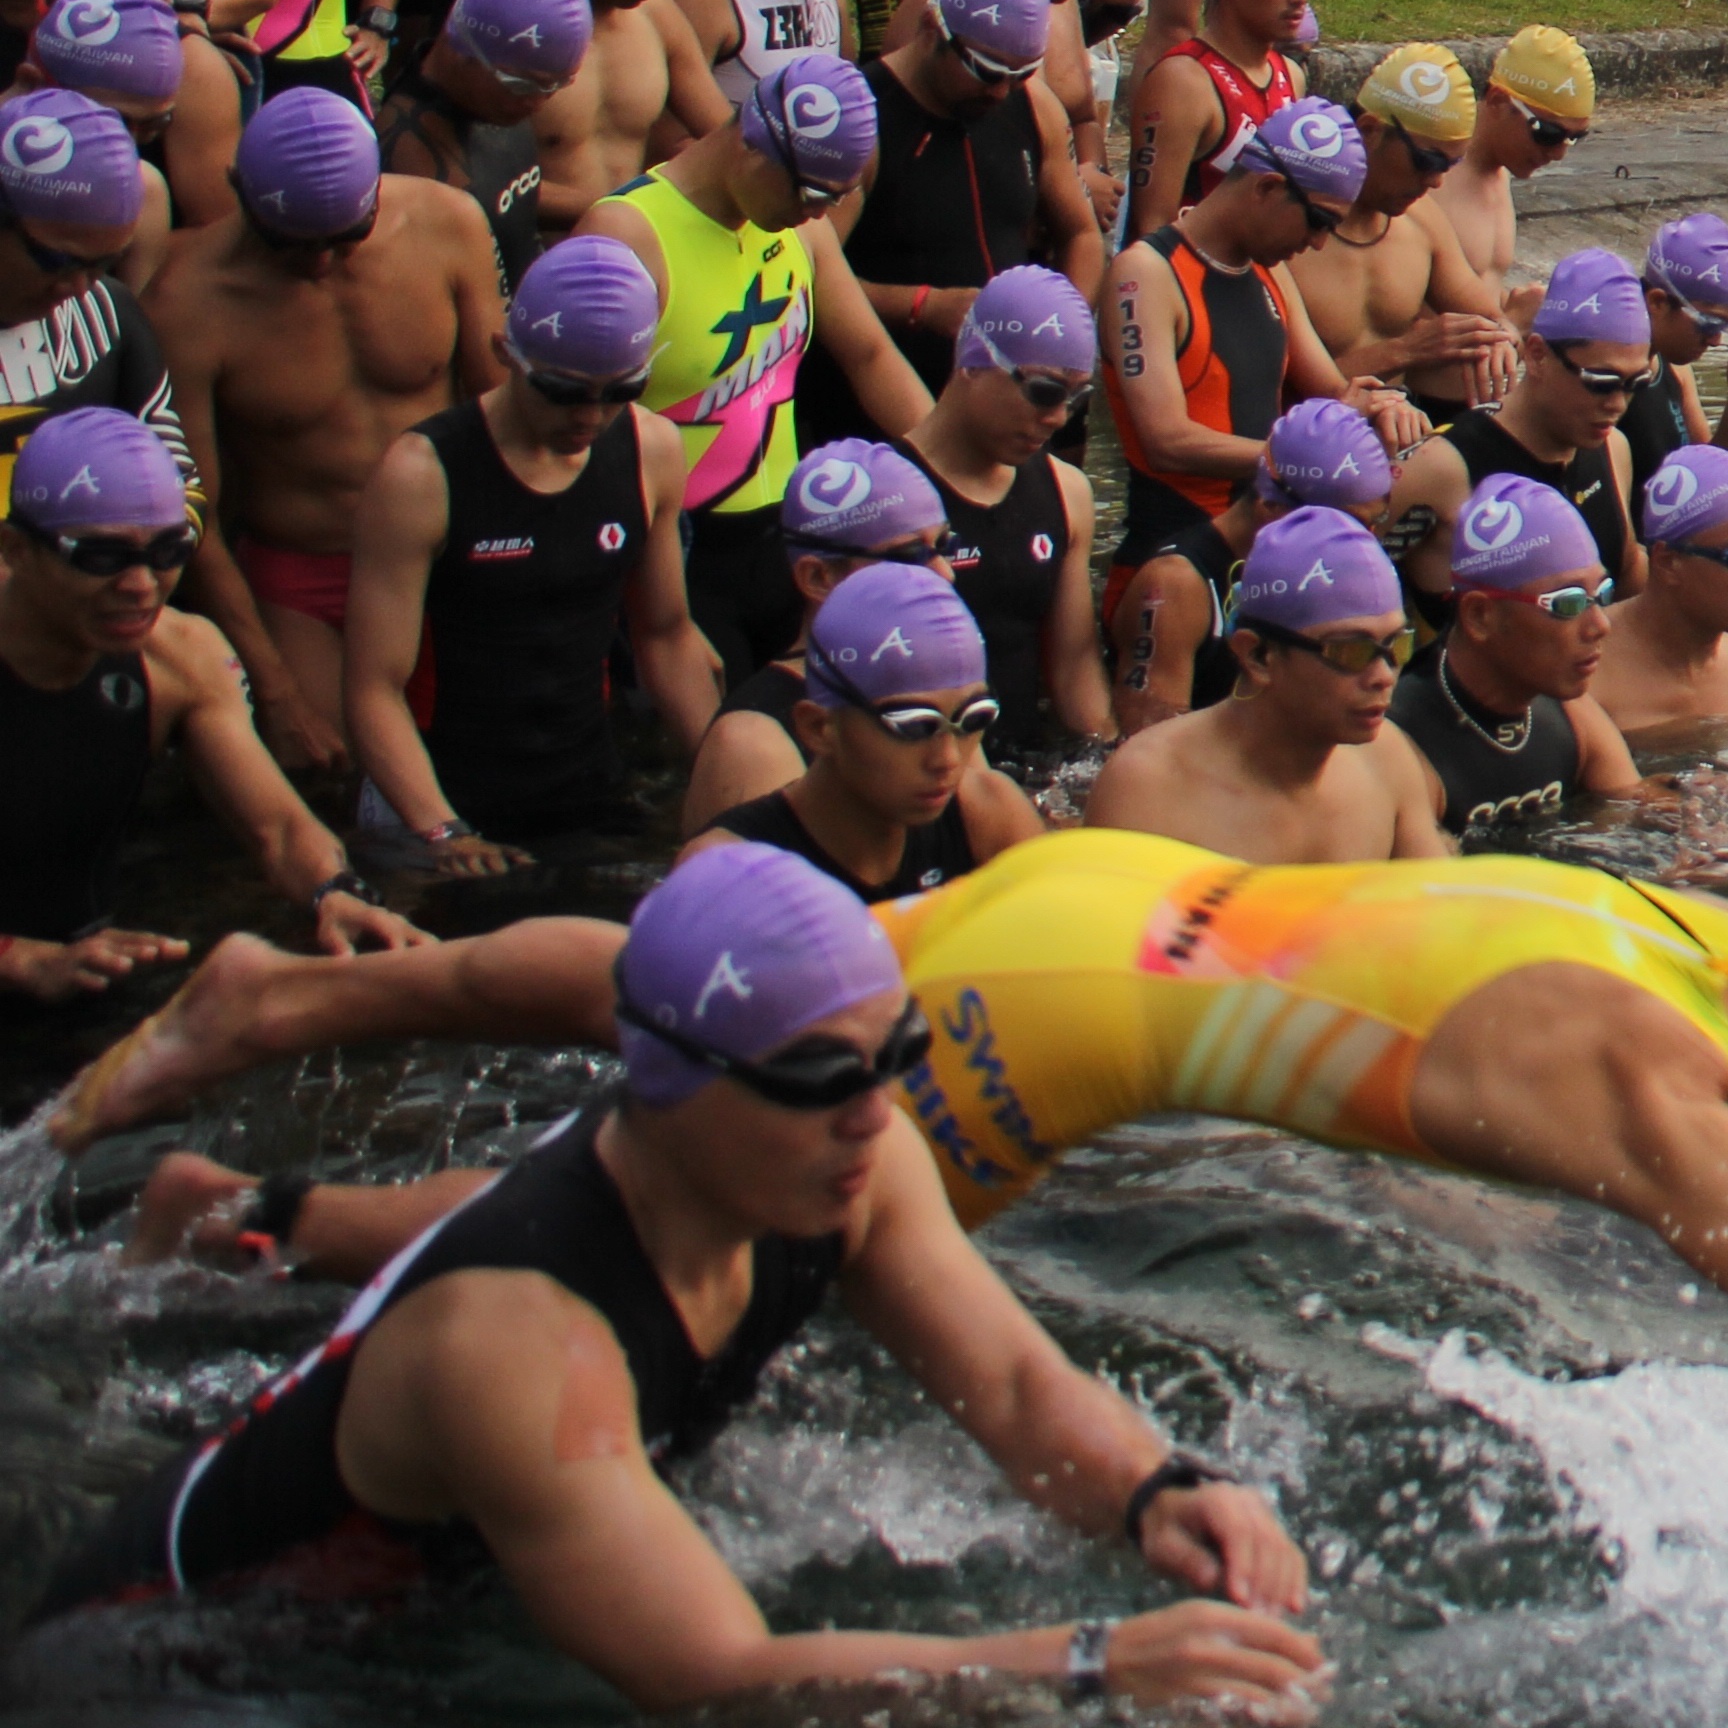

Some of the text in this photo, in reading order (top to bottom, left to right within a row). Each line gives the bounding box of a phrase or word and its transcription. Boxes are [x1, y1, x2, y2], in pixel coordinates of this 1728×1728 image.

[970, 3, 1002, 27] A
[508, 23, 544, 48] A
[1553, 76, 1579, 98] A
[499, 164, 542, 215] orca
[1696, 263, 1721, 283] A
[1572, 291, 1603, 316] A
[531, 310, 566, 339] A
[1031, 312, 1066, 338] A
[1119, 298, 1146, 378] 139
[1332, 451, 1361, 480] A
[59, 464, 101, 501] A
[840, 493, 905, 521] TAIWAN
[1493, 534, 1551, 560] TAIWAN
[1297, 556, 1336, 593] A
[870, 626, 915, 662] A
[694, 949, 753, 1018] A
